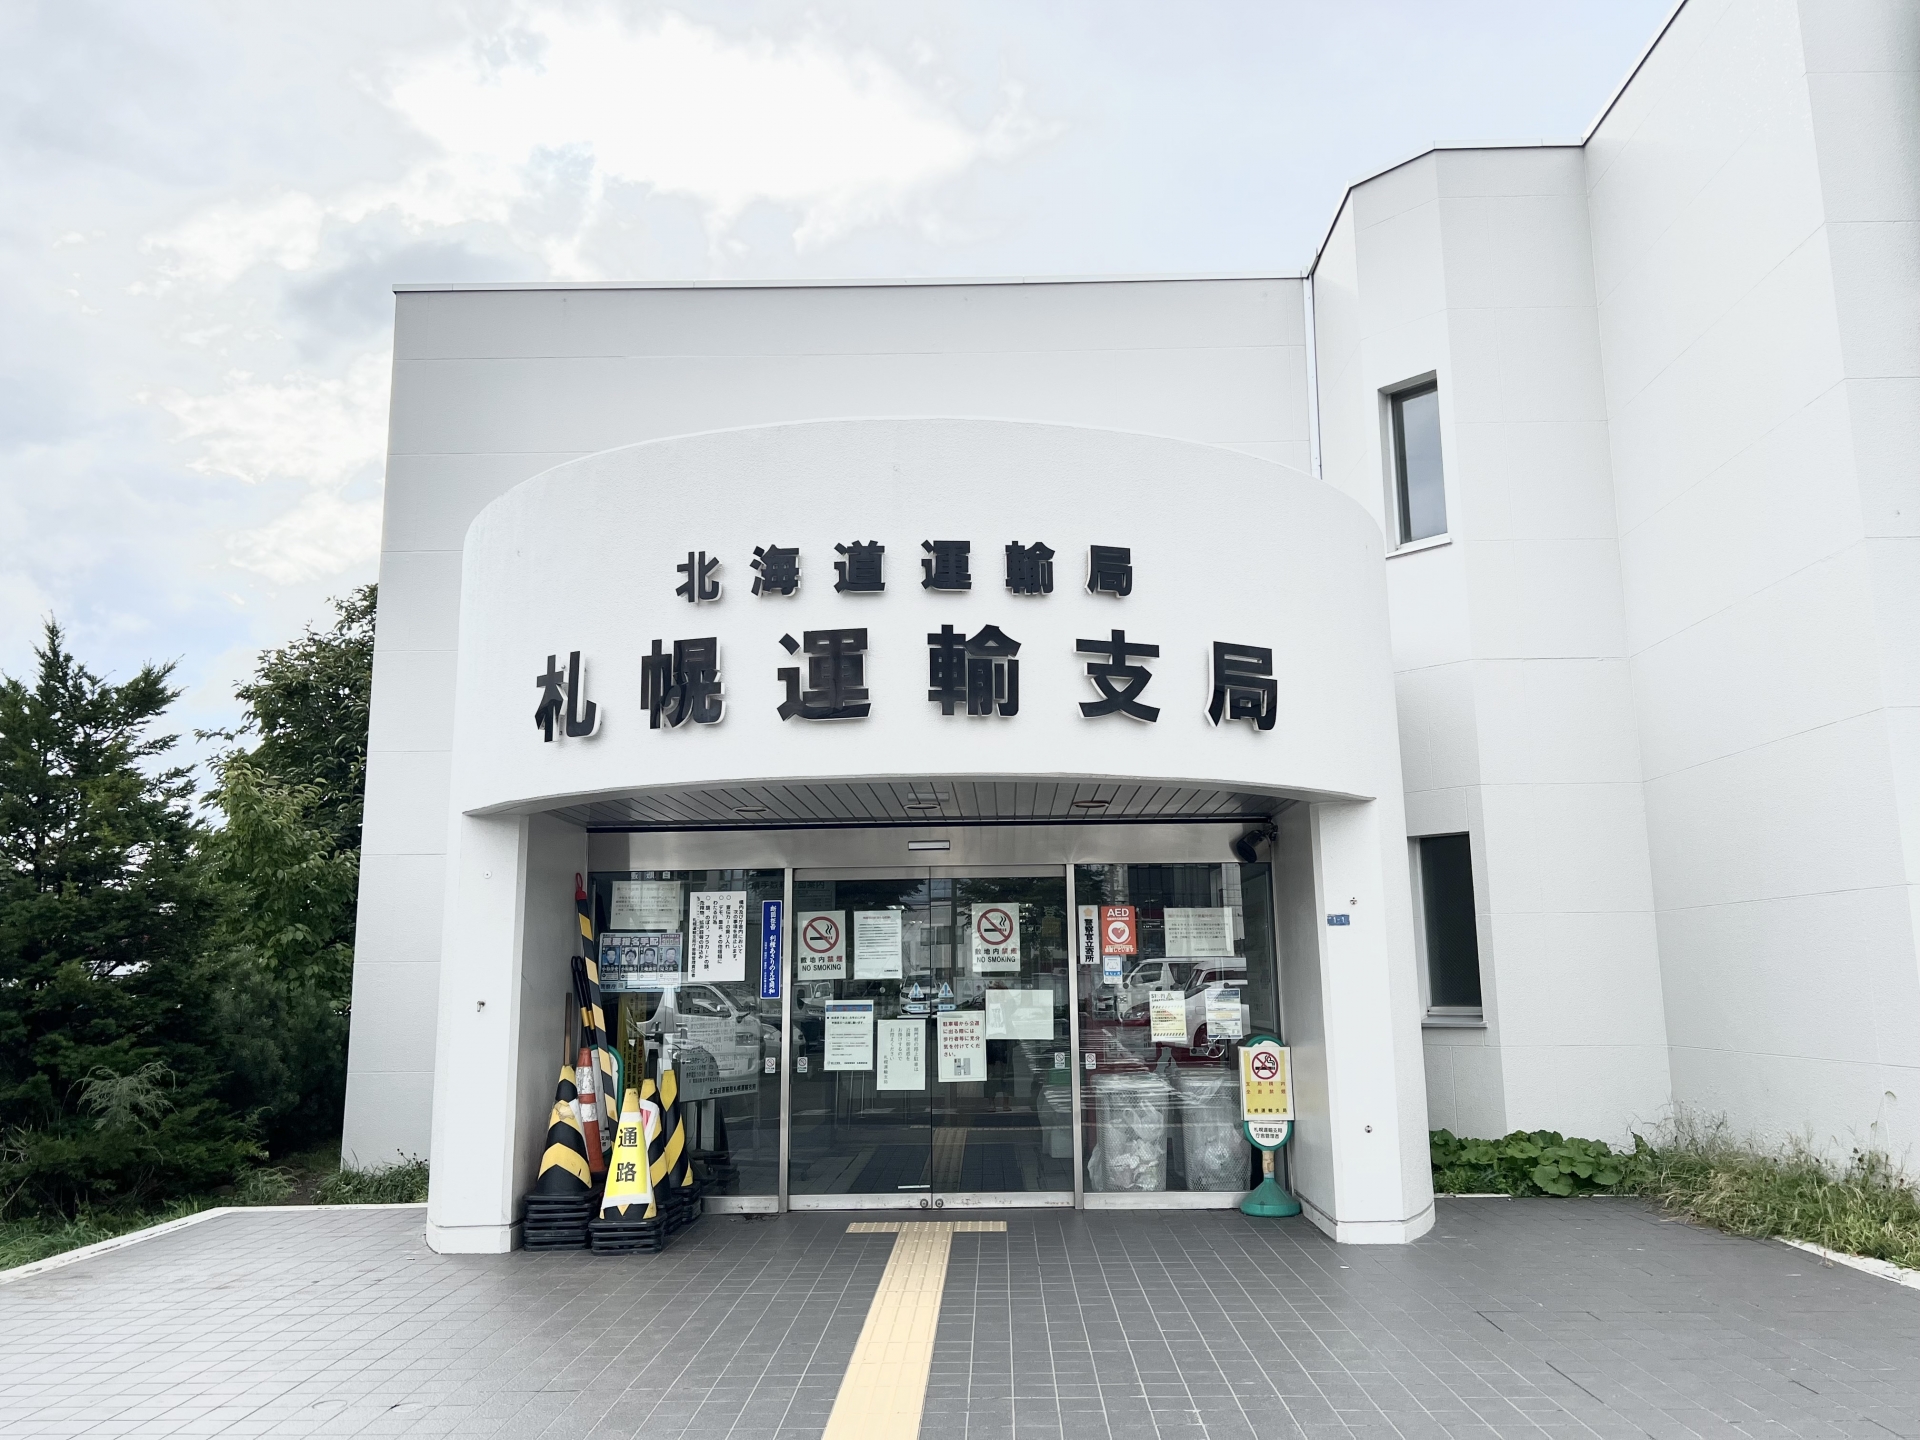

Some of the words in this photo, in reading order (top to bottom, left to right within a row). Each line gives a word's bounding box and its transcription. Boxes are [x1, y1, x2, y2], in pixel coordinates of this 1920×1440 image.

[676, 540, 1134, 602] 北海道運輸局
[534, 624, 1279, 743] 札幌運輸支局
[1084, 918, 1095, 963] 警察官立寄所
[1107, 908, 1130, 917] AED
[616, 1127, 638, 1183] 通路
